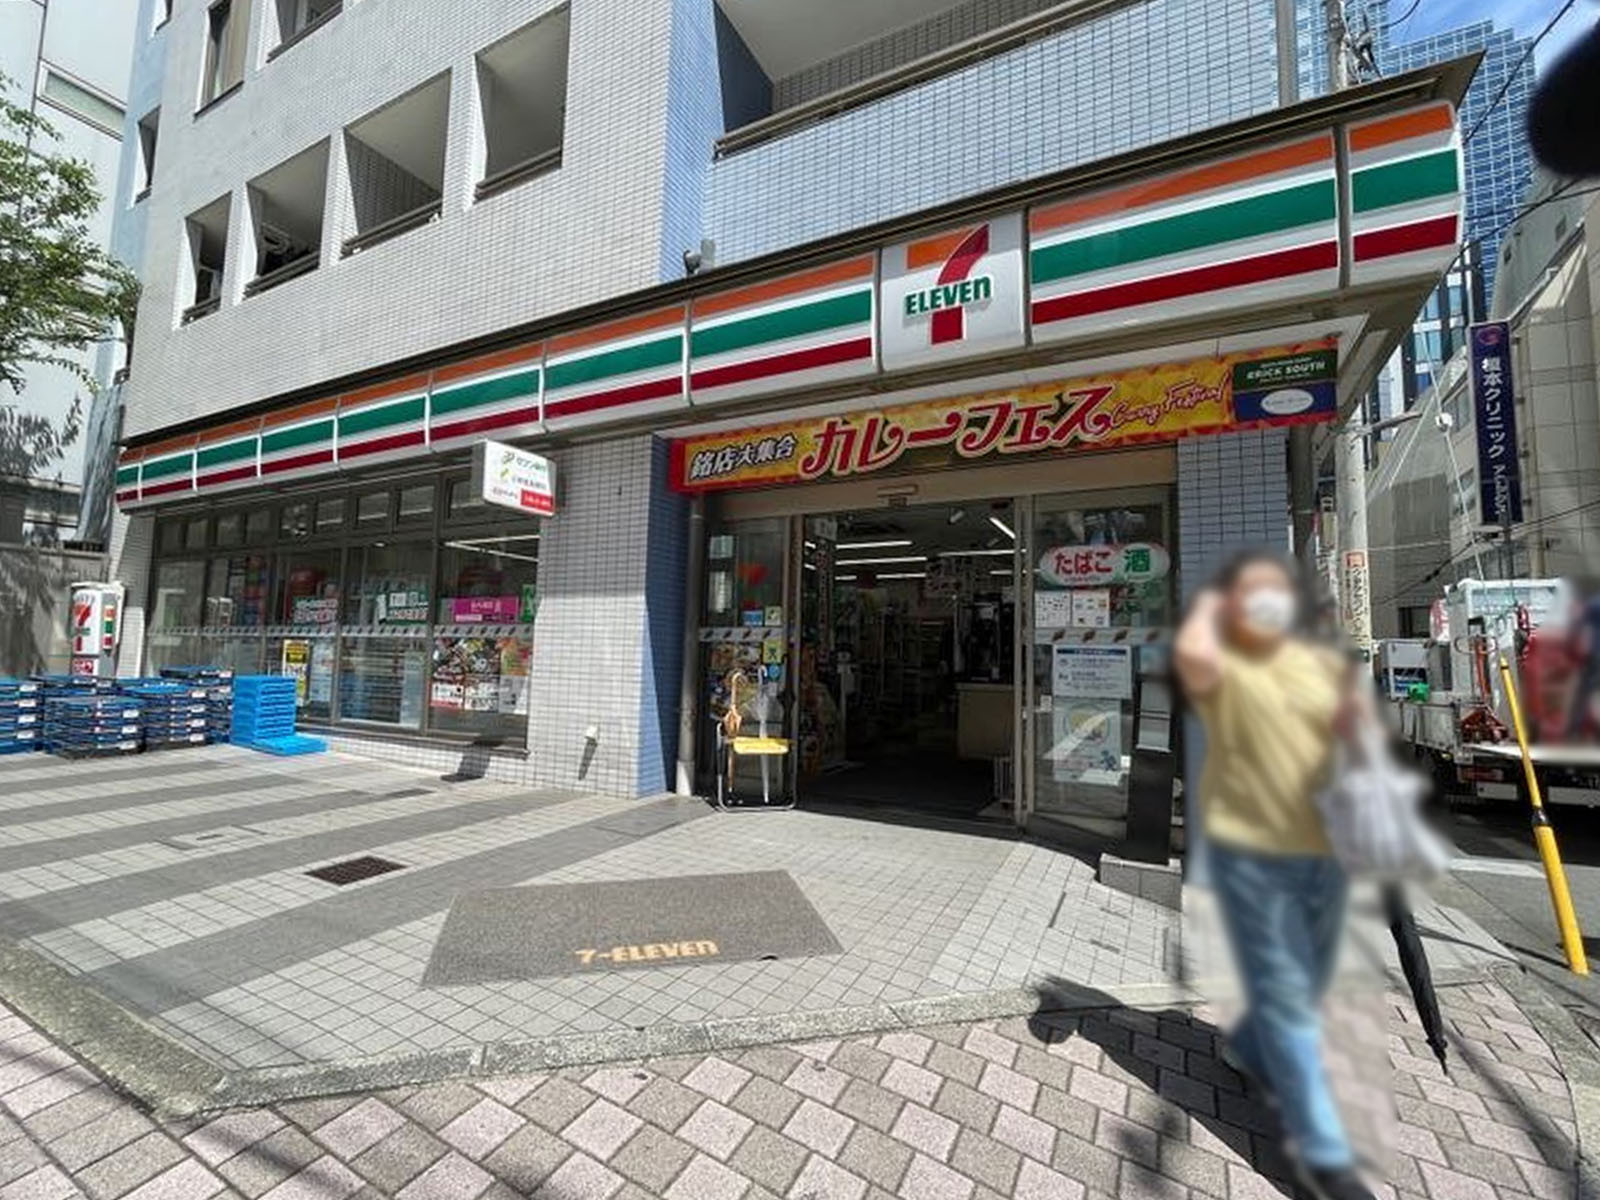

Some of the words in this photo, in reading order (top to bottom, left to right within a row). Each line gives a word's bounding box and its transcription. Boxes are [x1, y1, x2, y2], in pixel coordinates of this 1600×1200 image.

[802, 386, 1113, 474] カレーフェス
[1055, 550, 1113, 575] たばこ
[1123, 548, 1151, 573] 酒
